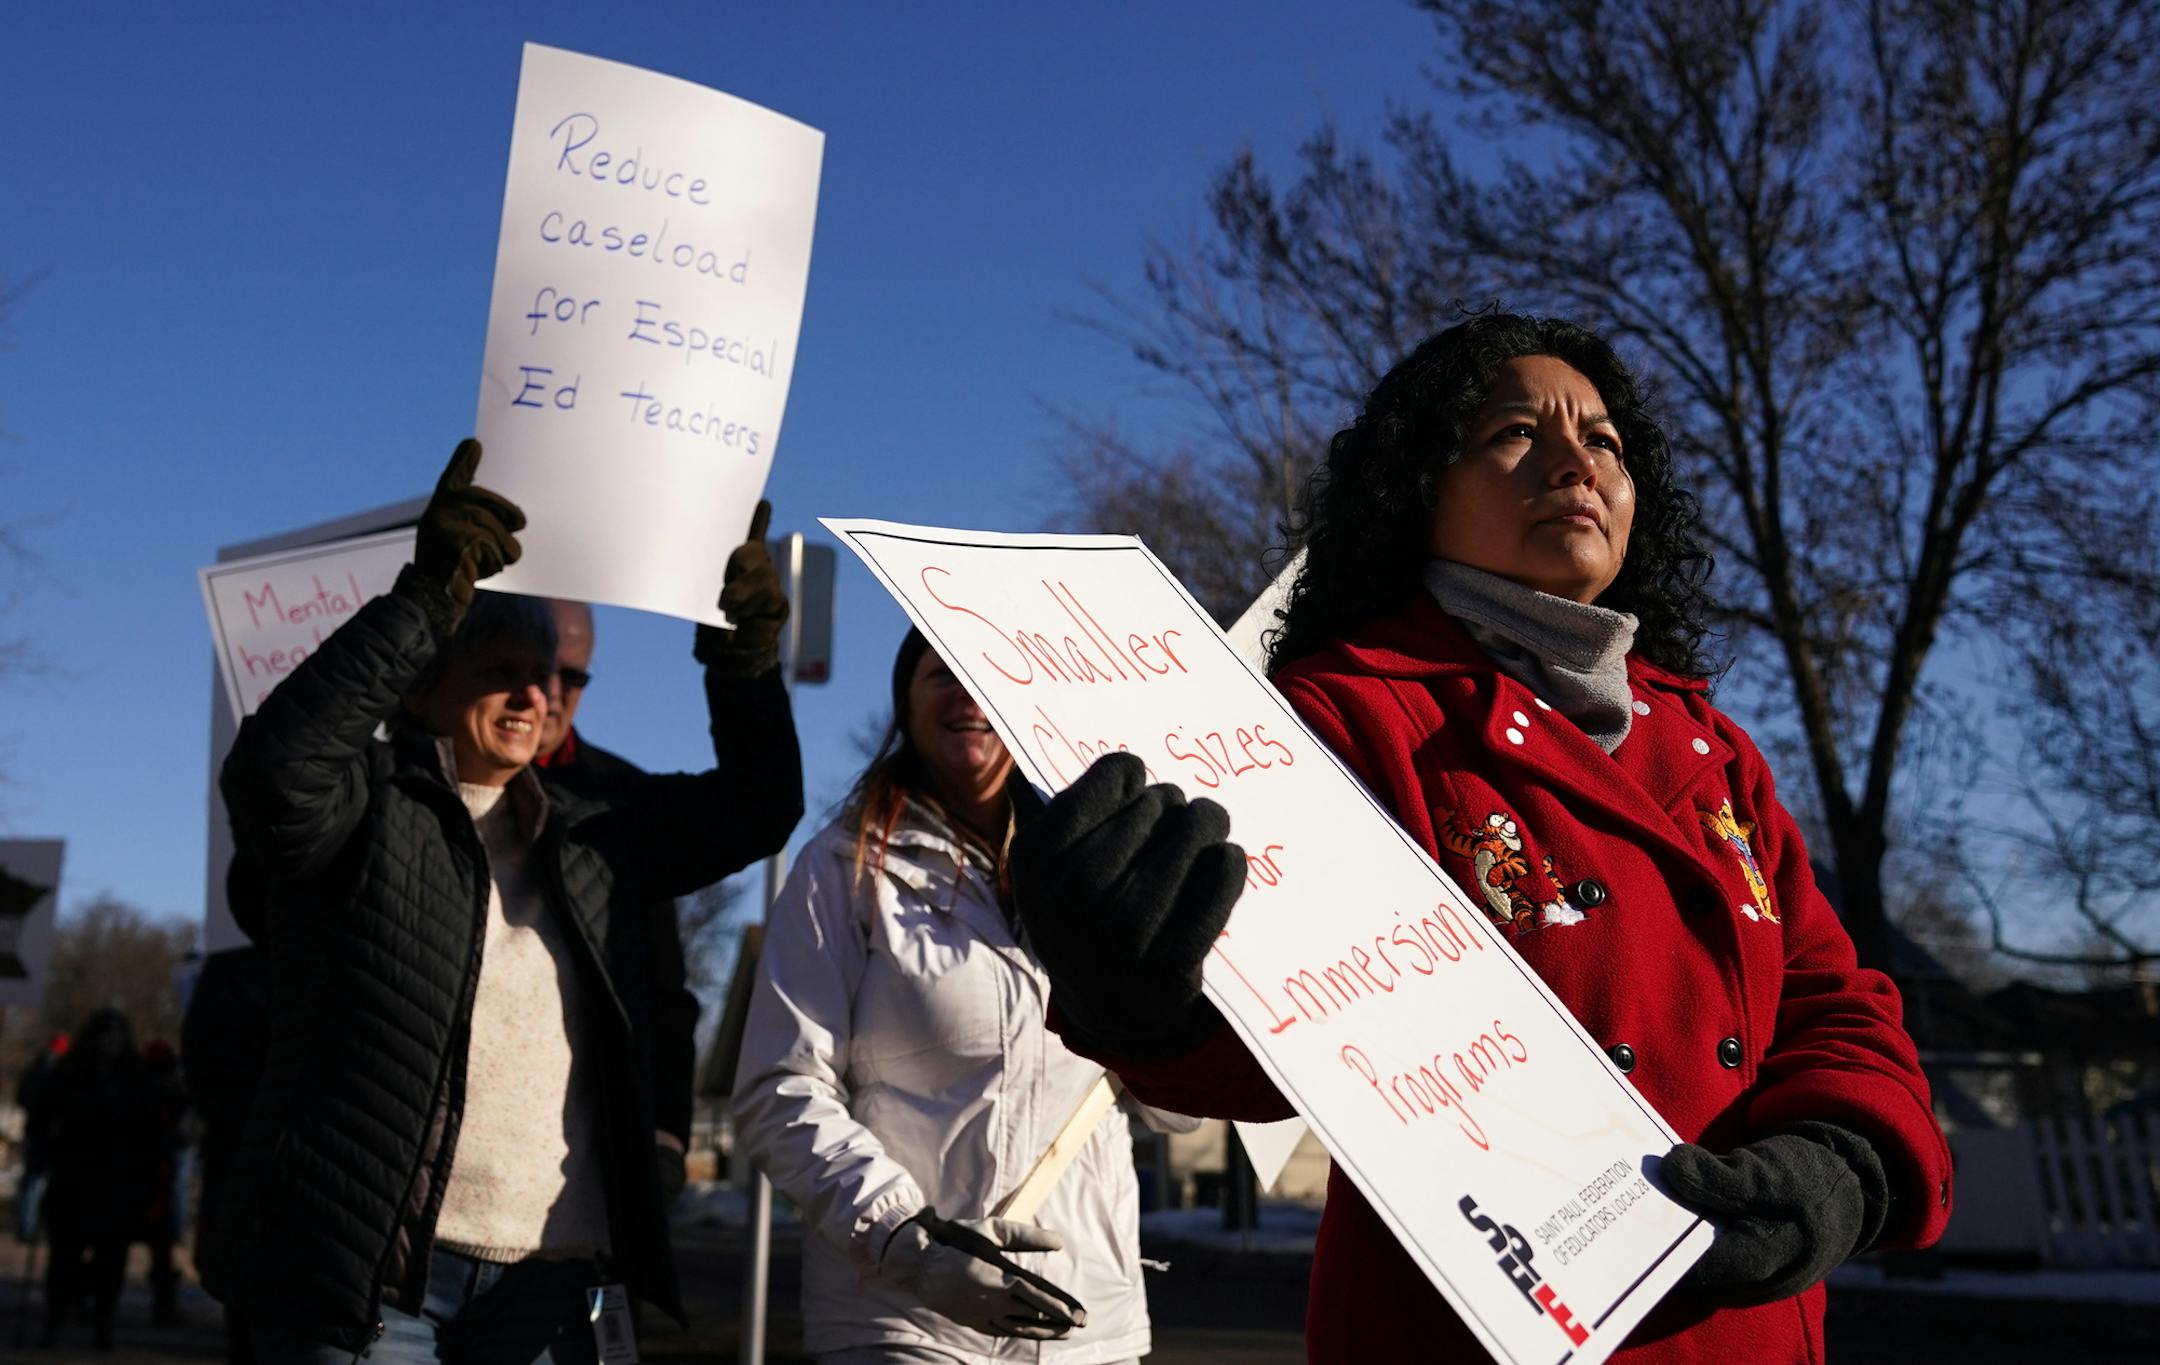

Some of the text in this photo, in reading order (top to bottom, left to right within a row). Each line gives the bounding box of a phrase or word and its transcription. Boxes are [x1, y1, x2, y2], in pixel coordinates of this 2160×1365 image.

[549, 112, 711, 205] Reduce
[539, 211, 752, 285] caseload
[526, 286, 778, 380] for Especial
[511, 365, 761, 455] Ed teachers
[244, 569, 364, 629] Mental
[920, 566, 1188, 685] Smaller
[1244, 844, 1284, 891] or
[1211, 902, 1484, 1035] Immersion
[1340, 1019, 1528, 1152] Programs
[1533, 1157, 1634, 1245] SAINT PAUL FEDERATION
[1552, 1177, 1651, 1266] OF EDUCATORS LOCAL 28
